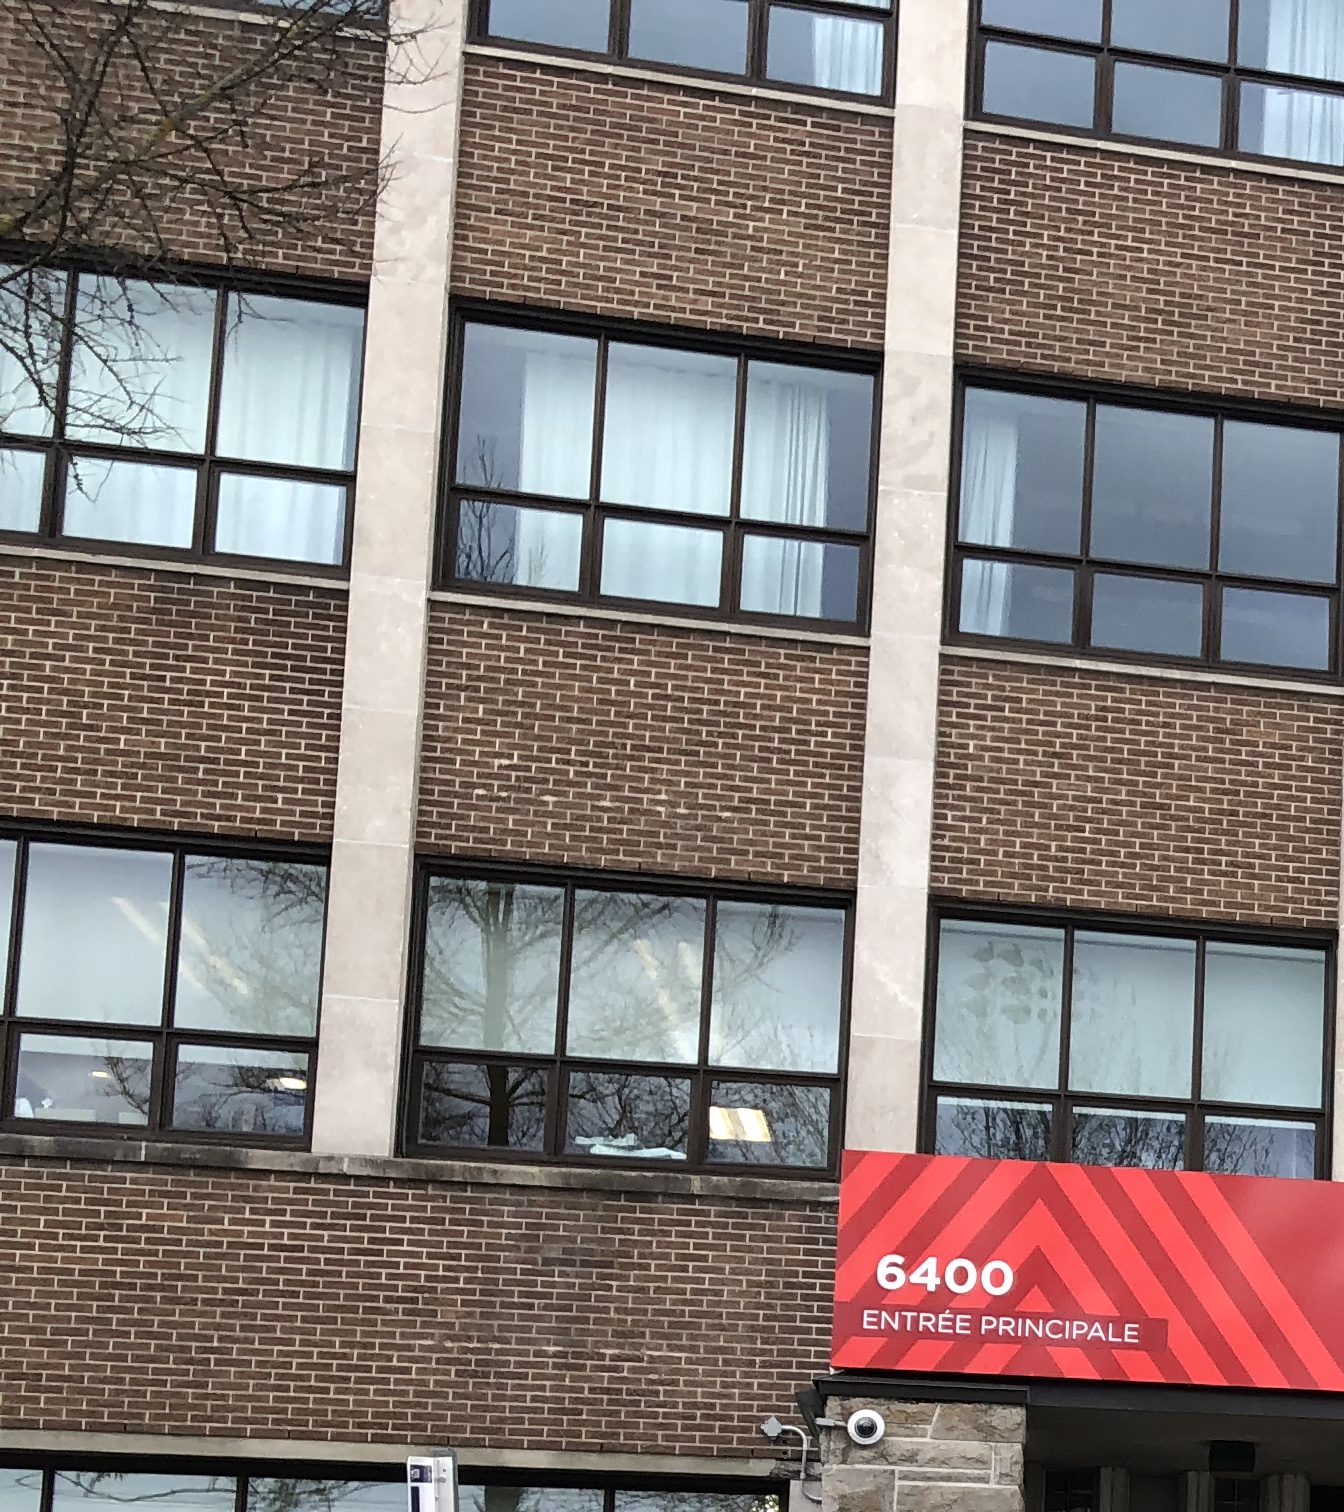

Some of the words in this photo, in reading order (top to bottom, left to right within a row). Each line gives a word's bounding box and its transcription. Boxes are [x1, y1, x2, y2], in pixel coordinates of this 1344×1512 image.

[876, 1254, 1014, 1296] 6400
[862, 1309, 972, 1335] ENTRÉE
[981, 1315, 1140, 1343] PRINCIPALE
